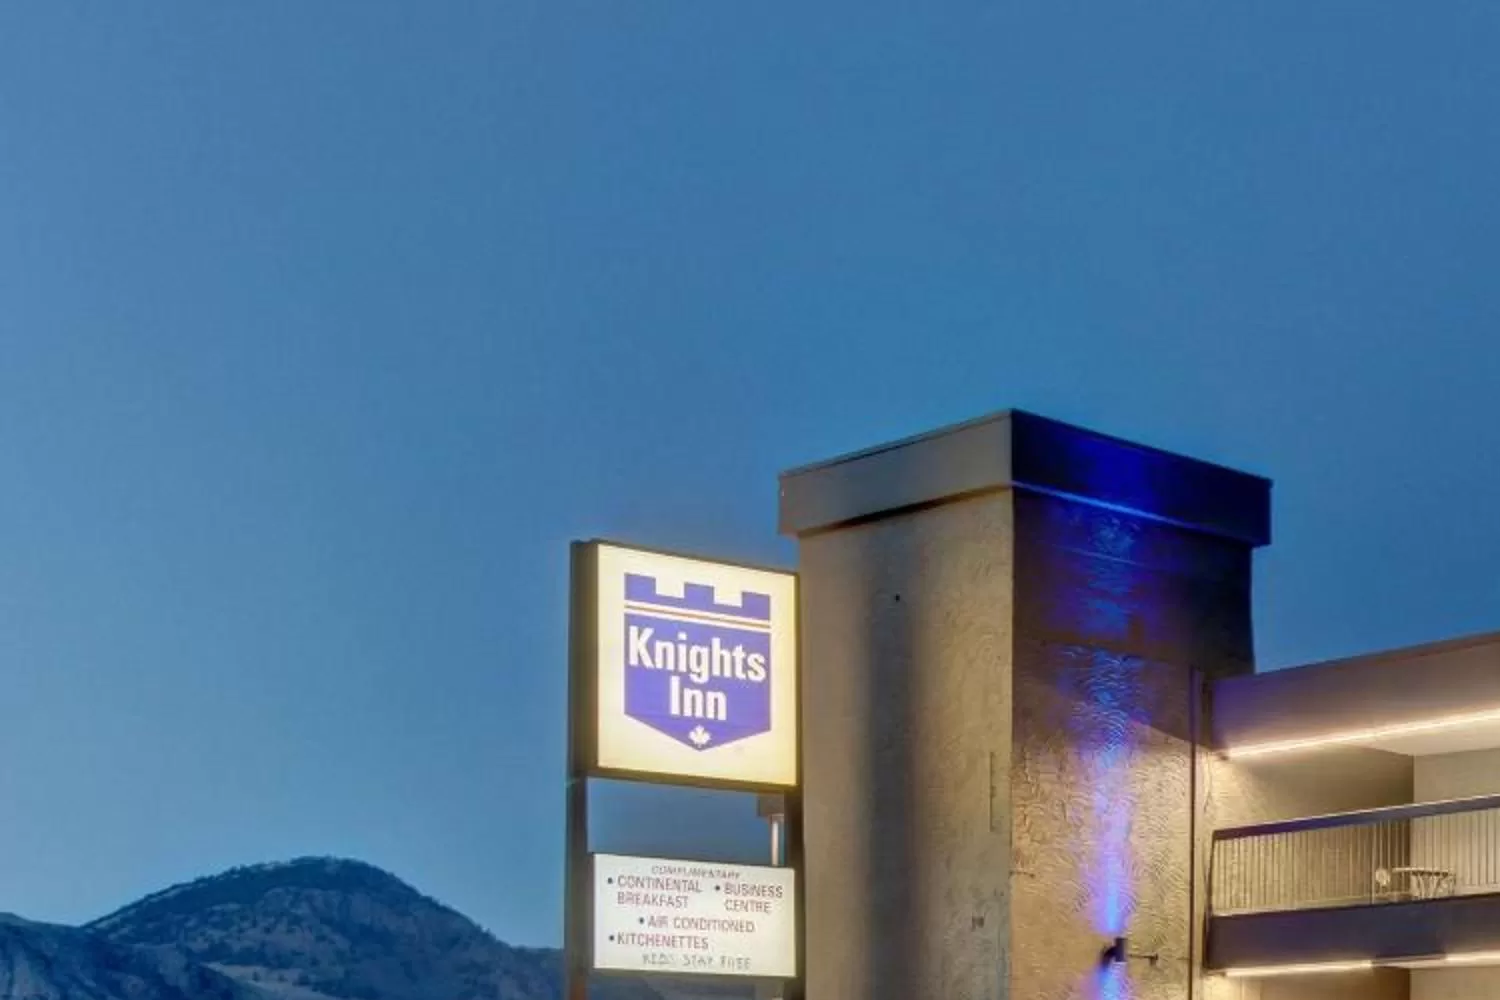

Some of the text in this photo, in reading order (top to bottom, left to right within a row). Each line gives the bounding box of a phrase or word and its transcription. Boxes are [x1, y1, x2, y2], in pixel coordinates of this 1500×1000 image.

[629, 625, 766, 683] Knights
[669, 676, 727, 721] Inn
[617, 874, 703, 893] CONTINENTAL
[723, 882, 784, 899] BUSINESS
[617, 892, 689, 909] BREAKFAST
[724, 899, 773, 914] CENTRE
[647, 916, 755, 933] AIR CONDITIONED
[617, 932, 709, 950] KITCHENETTES
